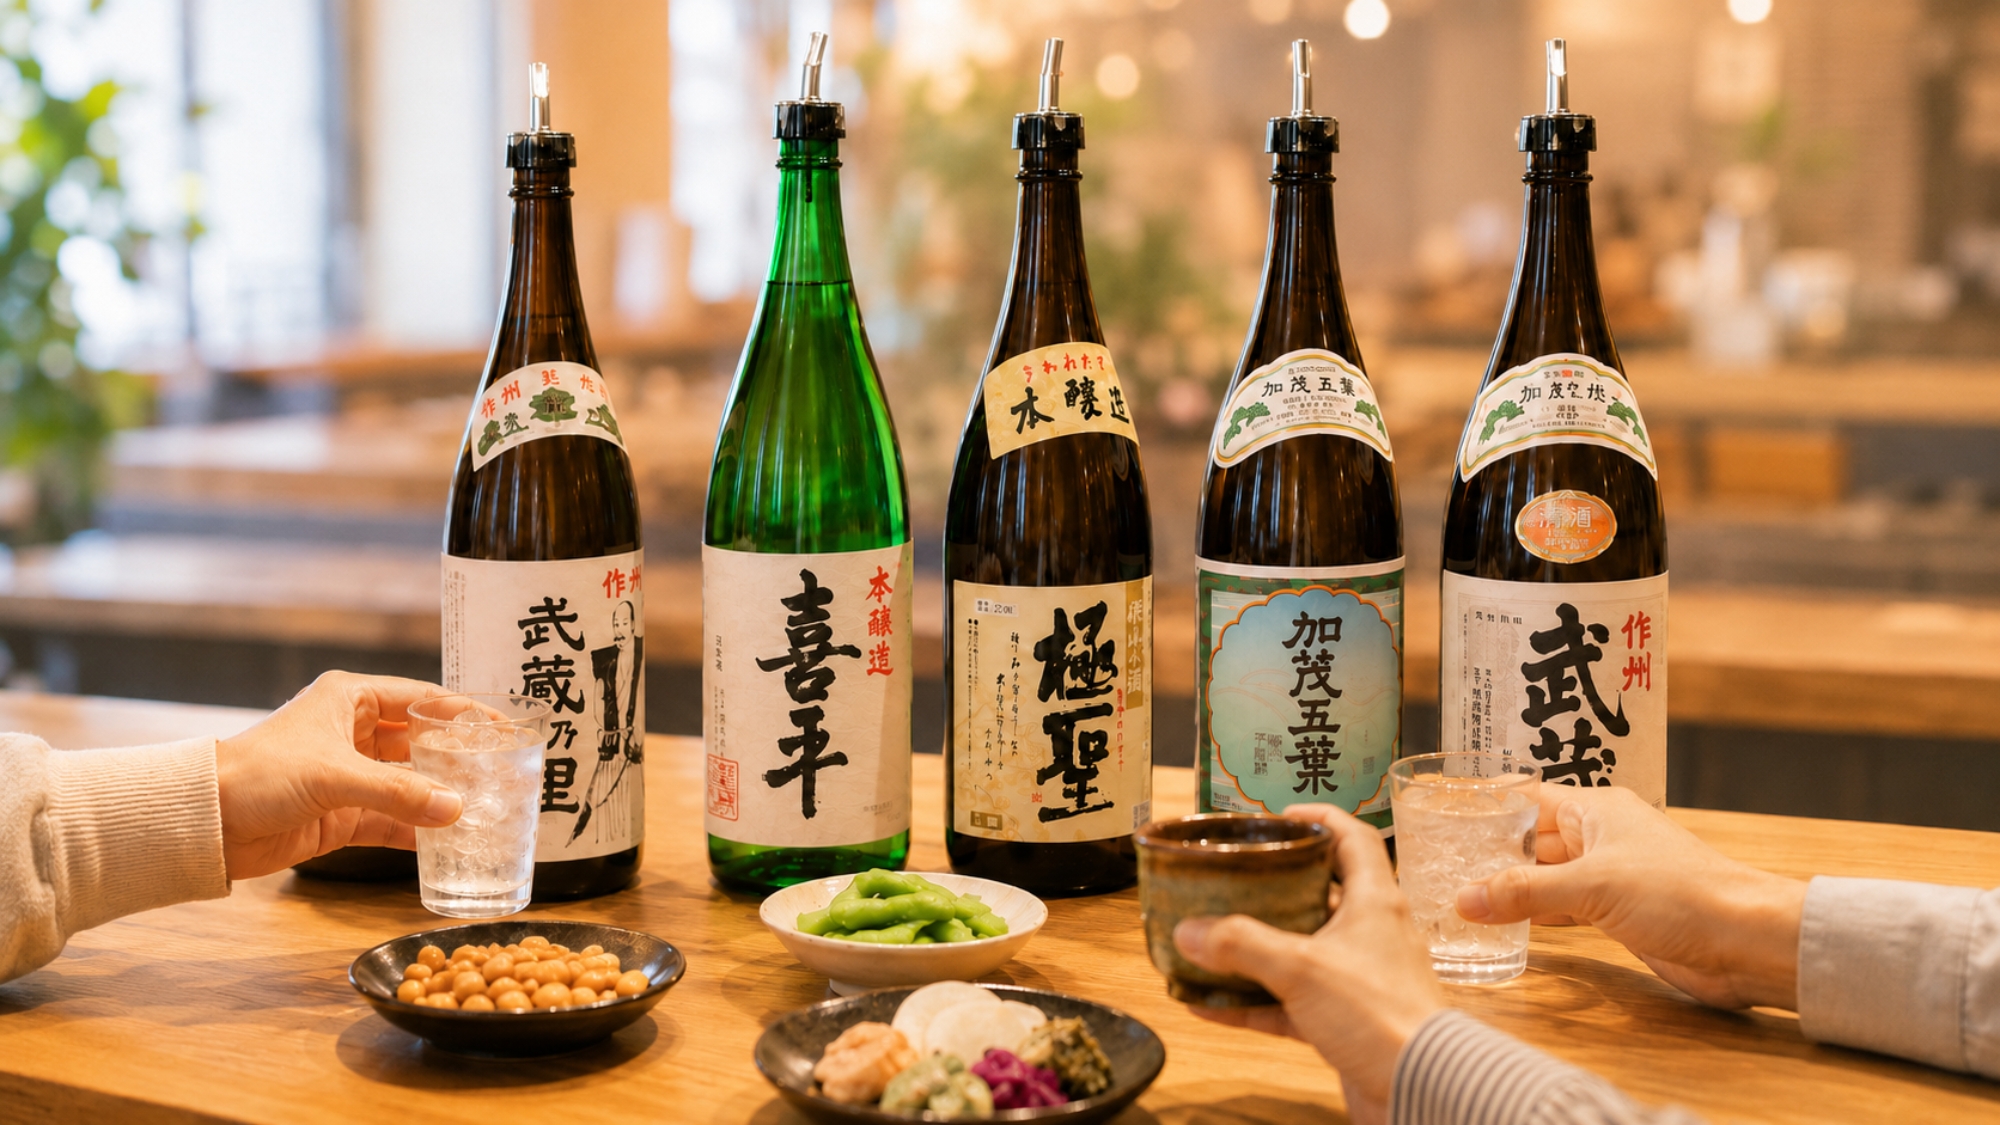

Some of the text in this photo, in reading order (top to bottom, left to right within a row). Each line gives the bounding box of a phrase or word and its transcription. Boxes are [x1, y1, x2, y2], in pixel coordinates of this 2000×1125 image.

[1261, 375, 1356, 398] 加茂五葉
[602, 565, 642, 599] 作州
[865, 565, 894, 677] 本醸造
[1621, 609, 1653, 692] 作州
[510, 596, 585, 814] 武蔵乃里
[755, 568, 862, 819] 喜平
[1033, 600, 1119, 823] 極聖
[1281, 610, 1343, 796] 加茂五葉
